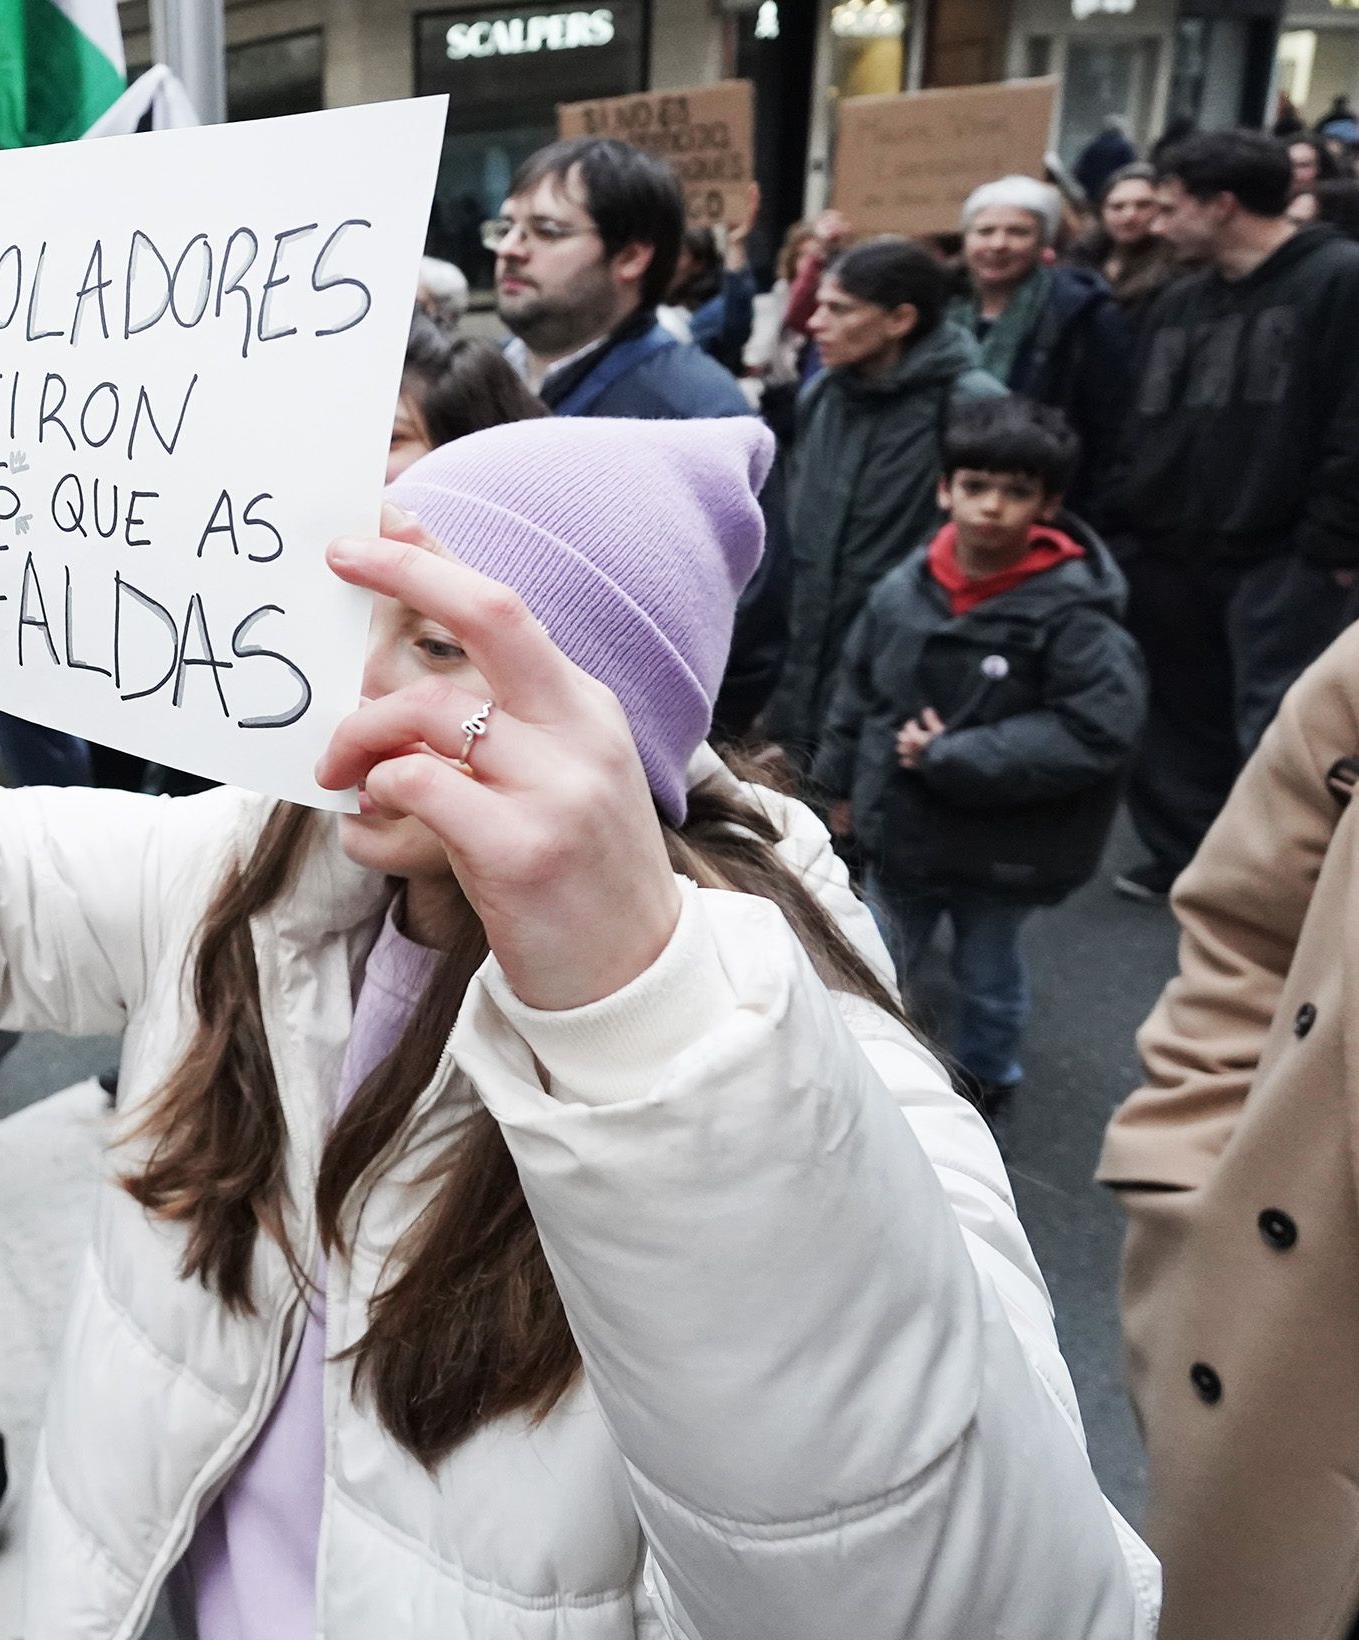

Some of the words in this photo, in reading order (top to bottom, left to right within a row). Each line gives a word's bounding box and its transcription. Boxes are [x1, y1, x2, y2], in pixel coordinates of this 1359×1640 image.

[445, 9, 615, 60] SCALPERS
[51, 473, 160, 547] QUE
[196, 489, 284, 563] AS
